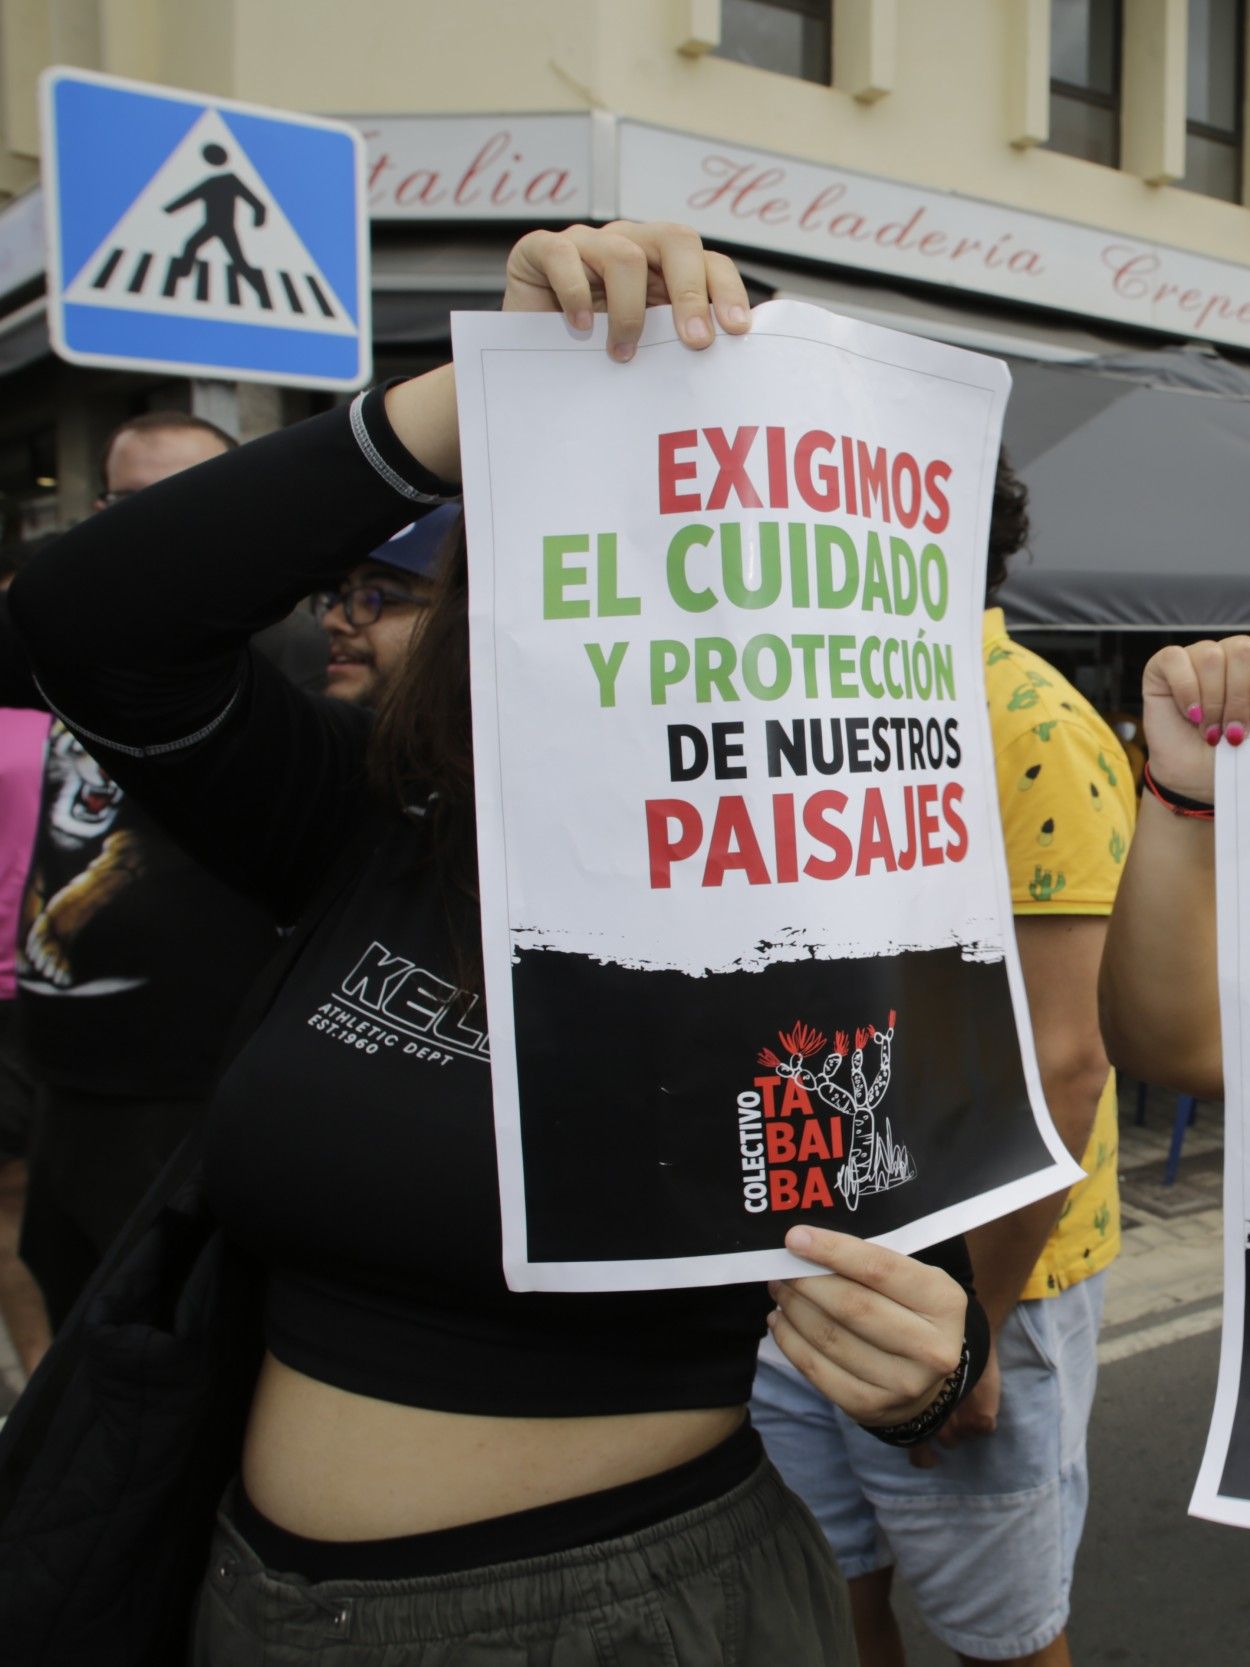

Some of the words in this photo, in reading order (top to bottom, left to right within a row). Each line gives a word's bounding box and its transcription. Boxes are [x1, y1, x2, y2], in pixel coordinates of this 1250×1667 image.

[364, 130, 578, 206] talia
[686, 154, 1046, 277] Heladería
[658, 427, 952, 534] EXIGIMOS
[543, 533, 641, 620] EL
[667, 523, 949, 621] CUIDADO
[586, 641, 628, 707] Y
[650, 628, 956, 706] PROTECCIÓN
[667, 721, 748, 782] DE
[765, 716, 962, 778] NUESTROS
[645, 781, 969, 889] PAISAJES
[307, 1013, 379, 1055] EST.1960
[318, 1002, 399, 1047] ATHLETIC
[403, 1042, 453, 1066] DEPT
[341, 941, 490, 1054] KEL
[754, 1075, 814, 1118] TA
[737, 1091, 768, 1213] COLECTIVO
[765, 1116, 844, 1164] BAI
[769, 1166, 834, 1212] BA
